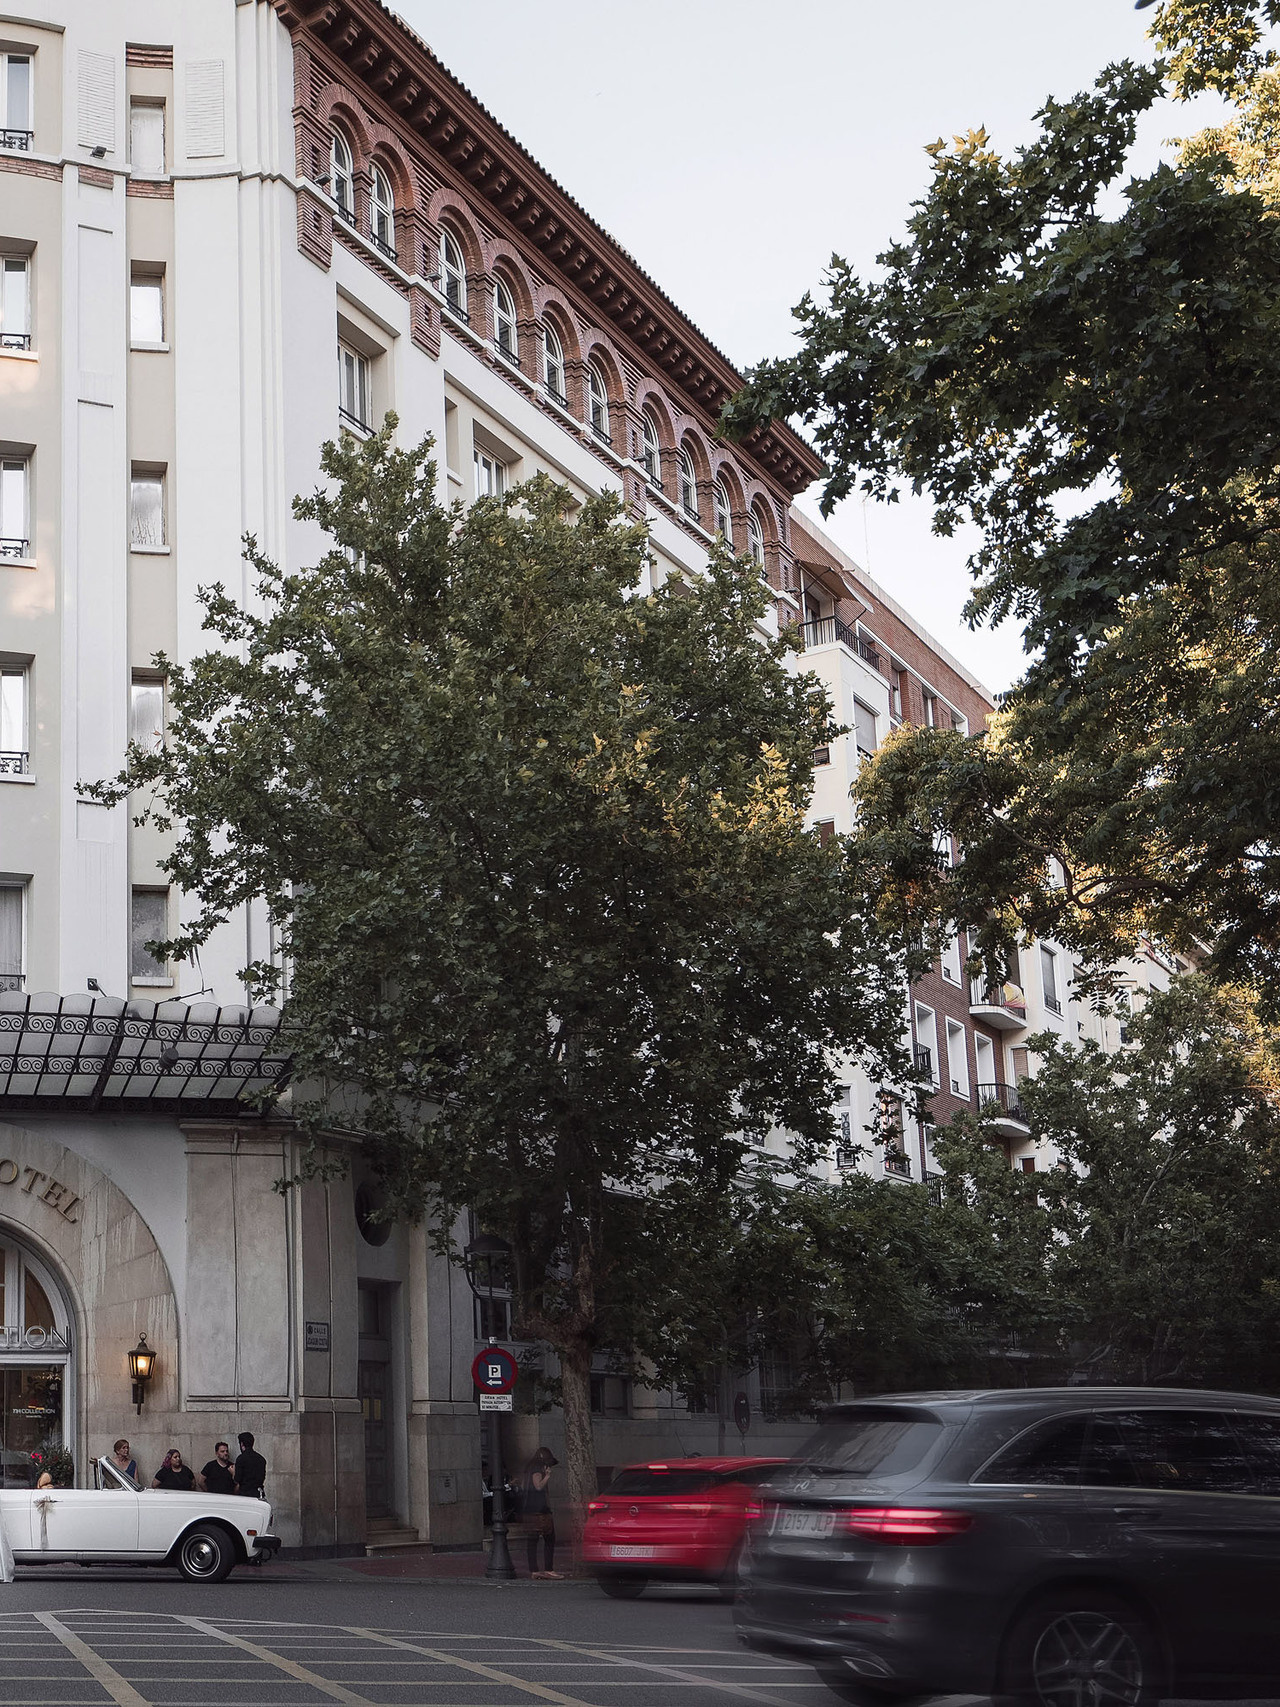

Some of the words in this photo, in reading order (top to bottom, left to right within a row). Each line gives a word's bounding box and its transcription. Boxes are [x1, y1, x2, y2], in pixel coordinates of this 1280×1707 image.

[491, 1367, 499, 1376] P
[784, 1513, 810, 1531] 2157
[811, 1514, 833, 1532] JLP
